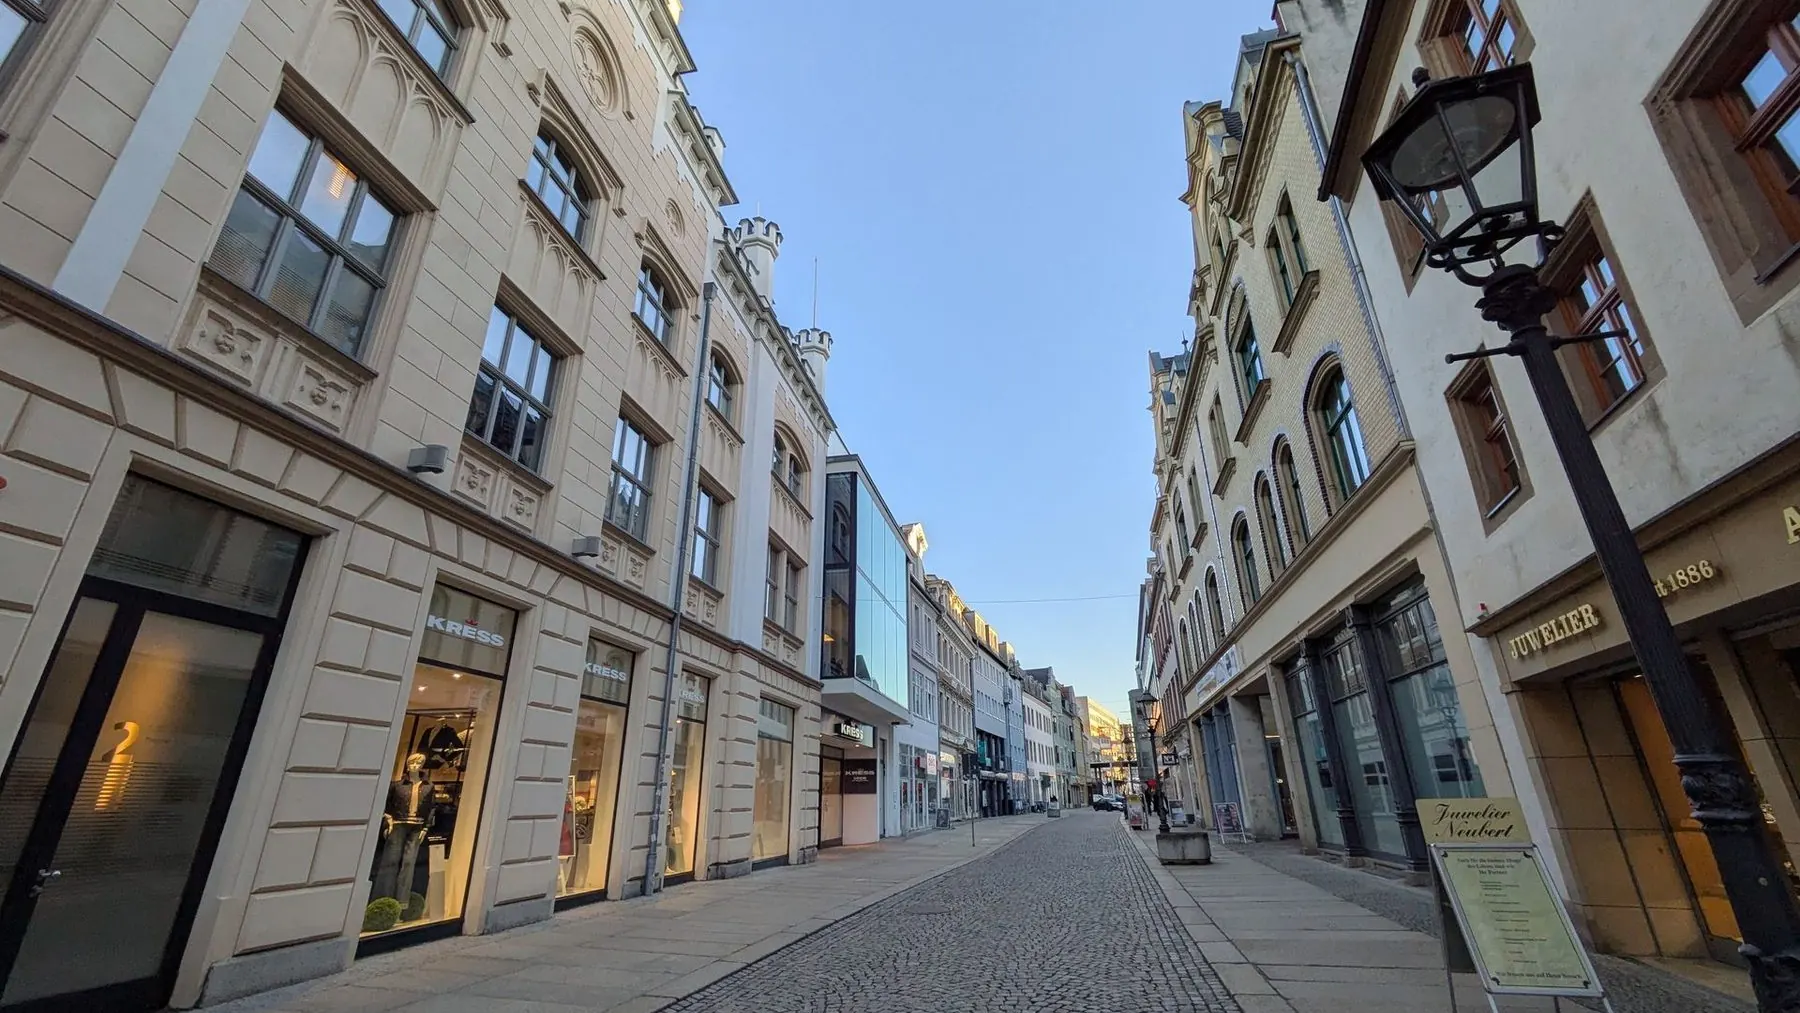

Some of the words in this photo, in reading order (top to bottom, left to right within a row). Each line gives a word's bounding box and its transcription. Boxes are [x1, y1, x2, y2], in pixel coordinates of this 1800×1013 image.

[1508, 604, 1599, 660] JUWELIER
[1667, 560, 1714, 592] 1886
[427, 615, 505, 647] KRESS
[841, 723, 864, 740] KRESS
[1432, 803, 1511, 825] Juwelier
[1435, 820, 1514, 838] Neubert
